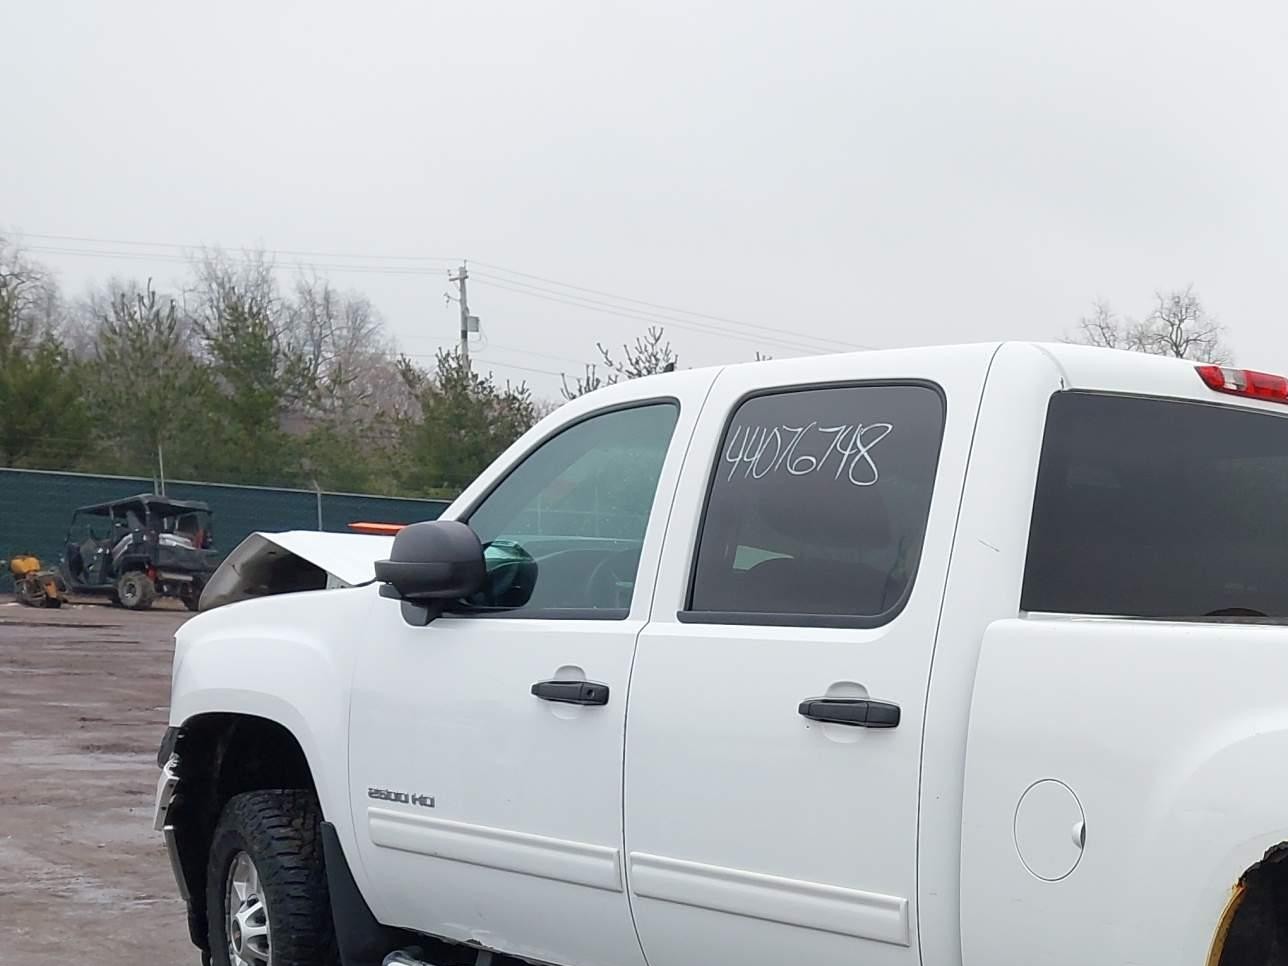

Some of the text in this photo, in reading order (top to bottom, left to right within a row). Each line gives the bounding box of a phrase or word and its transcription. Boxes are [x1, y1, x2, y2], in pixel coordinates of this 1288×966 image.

[726, 421, 894, 486] 44076748
[367, 787, 435, 808] 2500 HD
